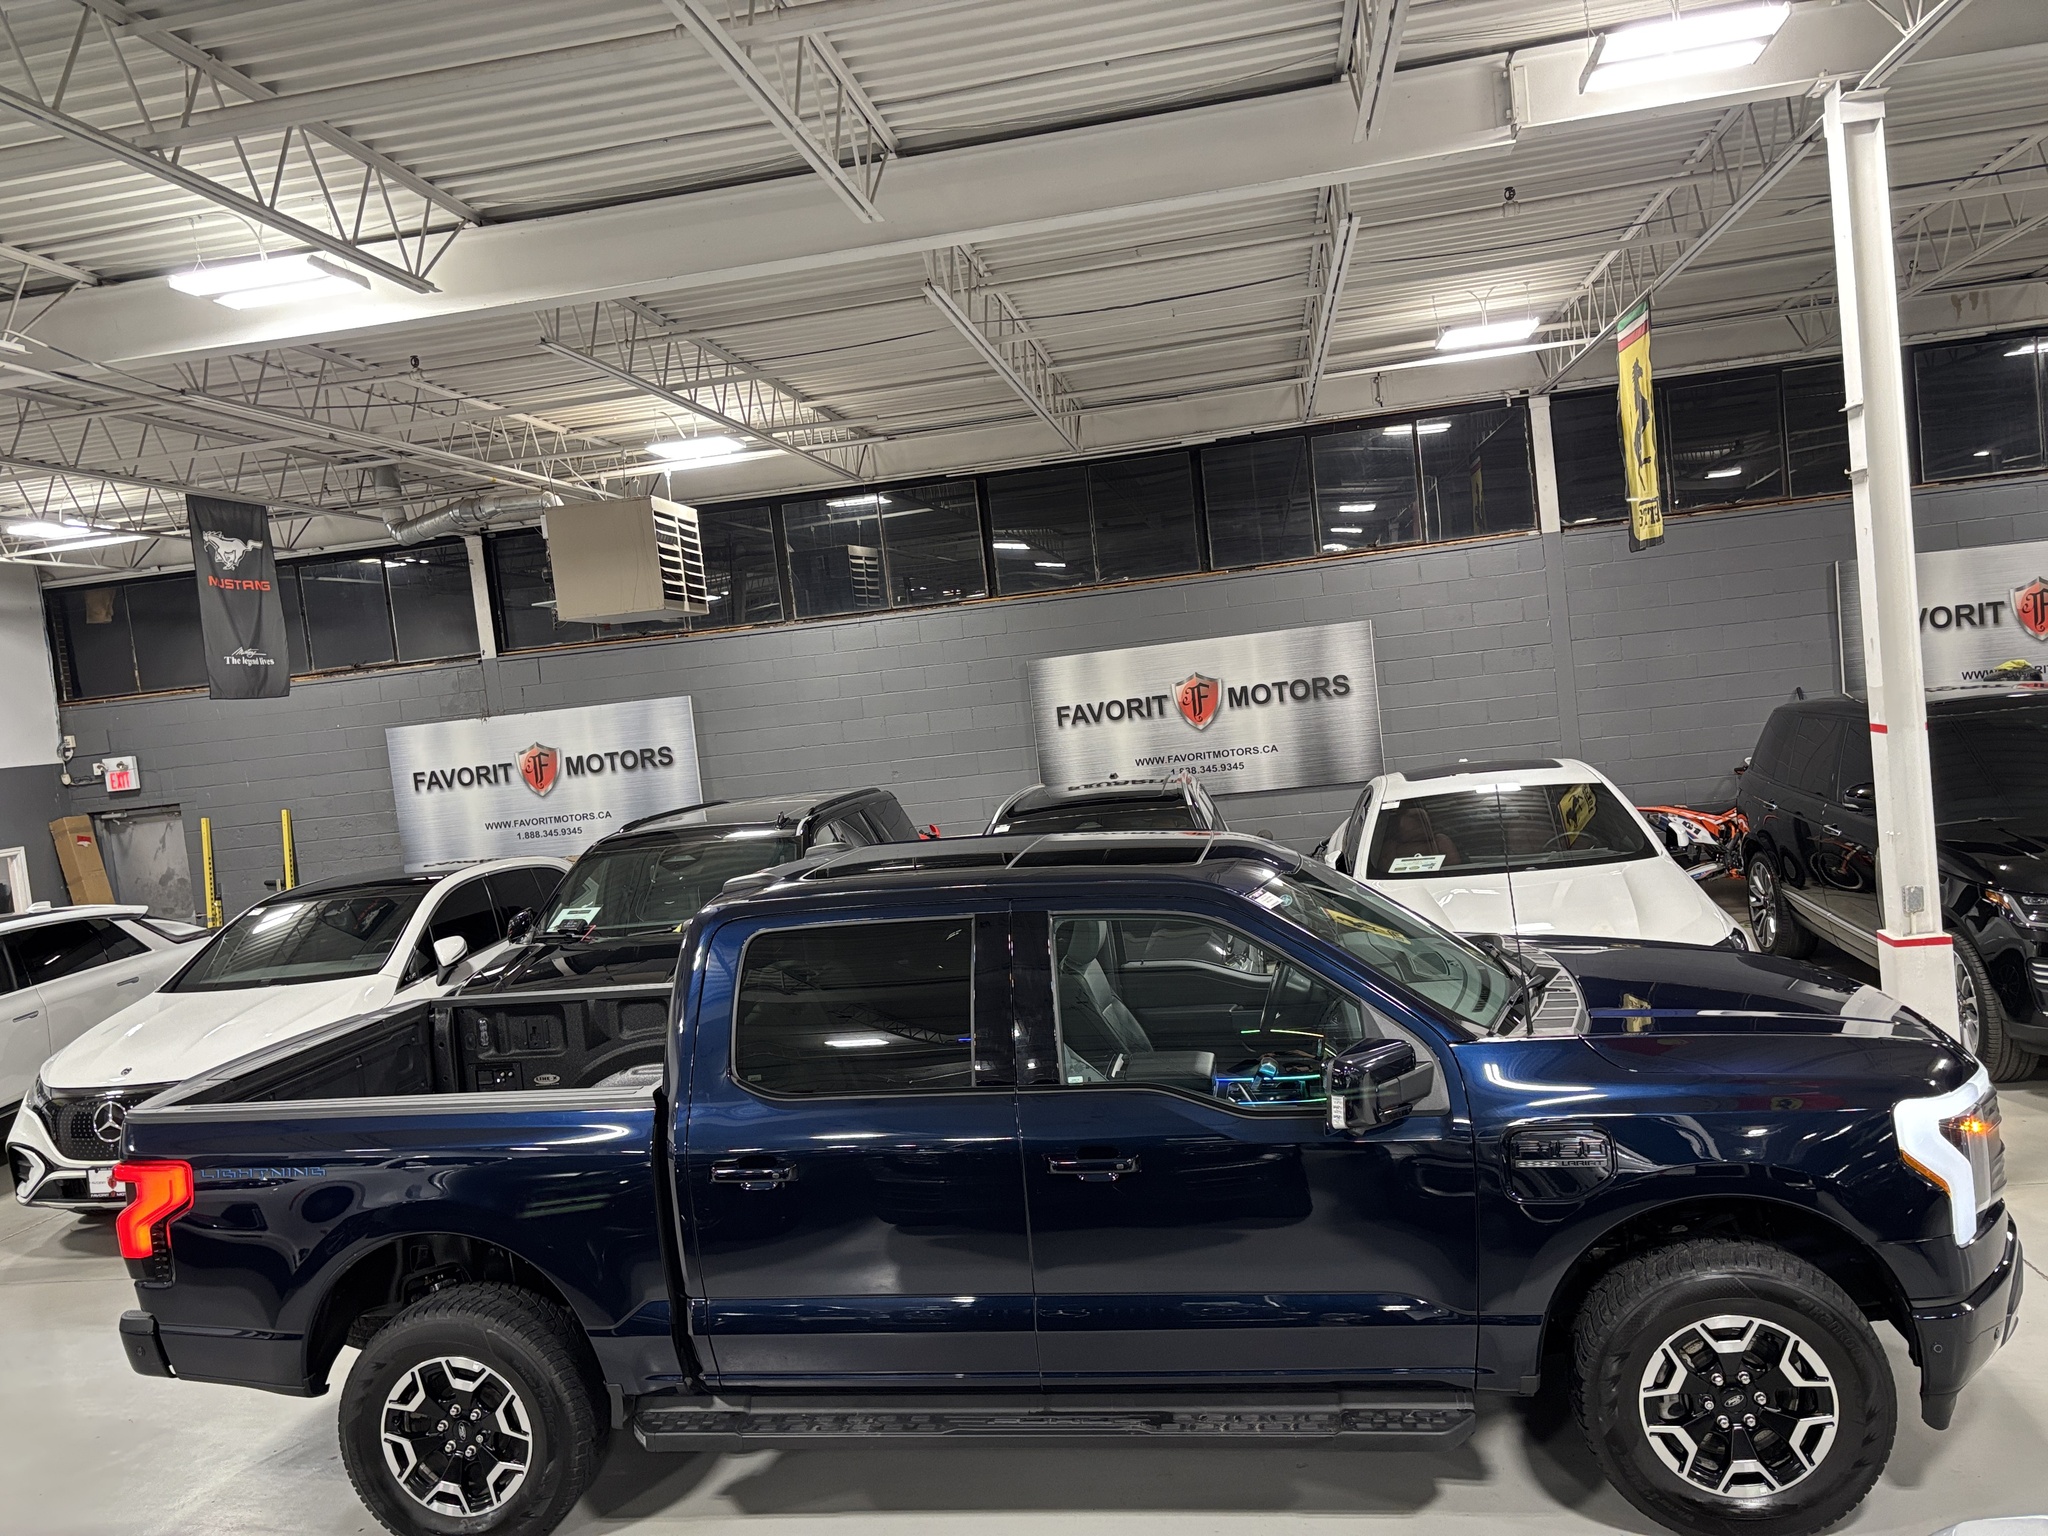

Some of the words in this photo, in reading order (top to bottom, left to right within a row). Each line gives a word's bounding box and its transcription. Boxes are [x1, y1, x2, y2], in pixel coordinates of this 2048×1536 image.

[208, 575, 271, 591] MUSTANG
[1919, 600, 2005, 628] ORIT
[224, 656, 241, 665] The
[1056, 694, 1168, 727] FAVORIT
[1227, 674, 1351, 708] MOTORS
[1134, 744, 1279, 767] WWW.FAVORITMOTORS.CA
[413, 762, 512, 792] FAVORIT
[565, 746, 674, 776] MOTORS
[1170, 761, 1245, 775] 1888.345.9345
[109, 771, 131, 790] EXIT
[484, 811, 612, 831] WWW.FAVORITMOTORS.CA
[516, 827, 583, 840] 1.888.345.9345
[201, 1166, 327, 1179] LIGHTNING
